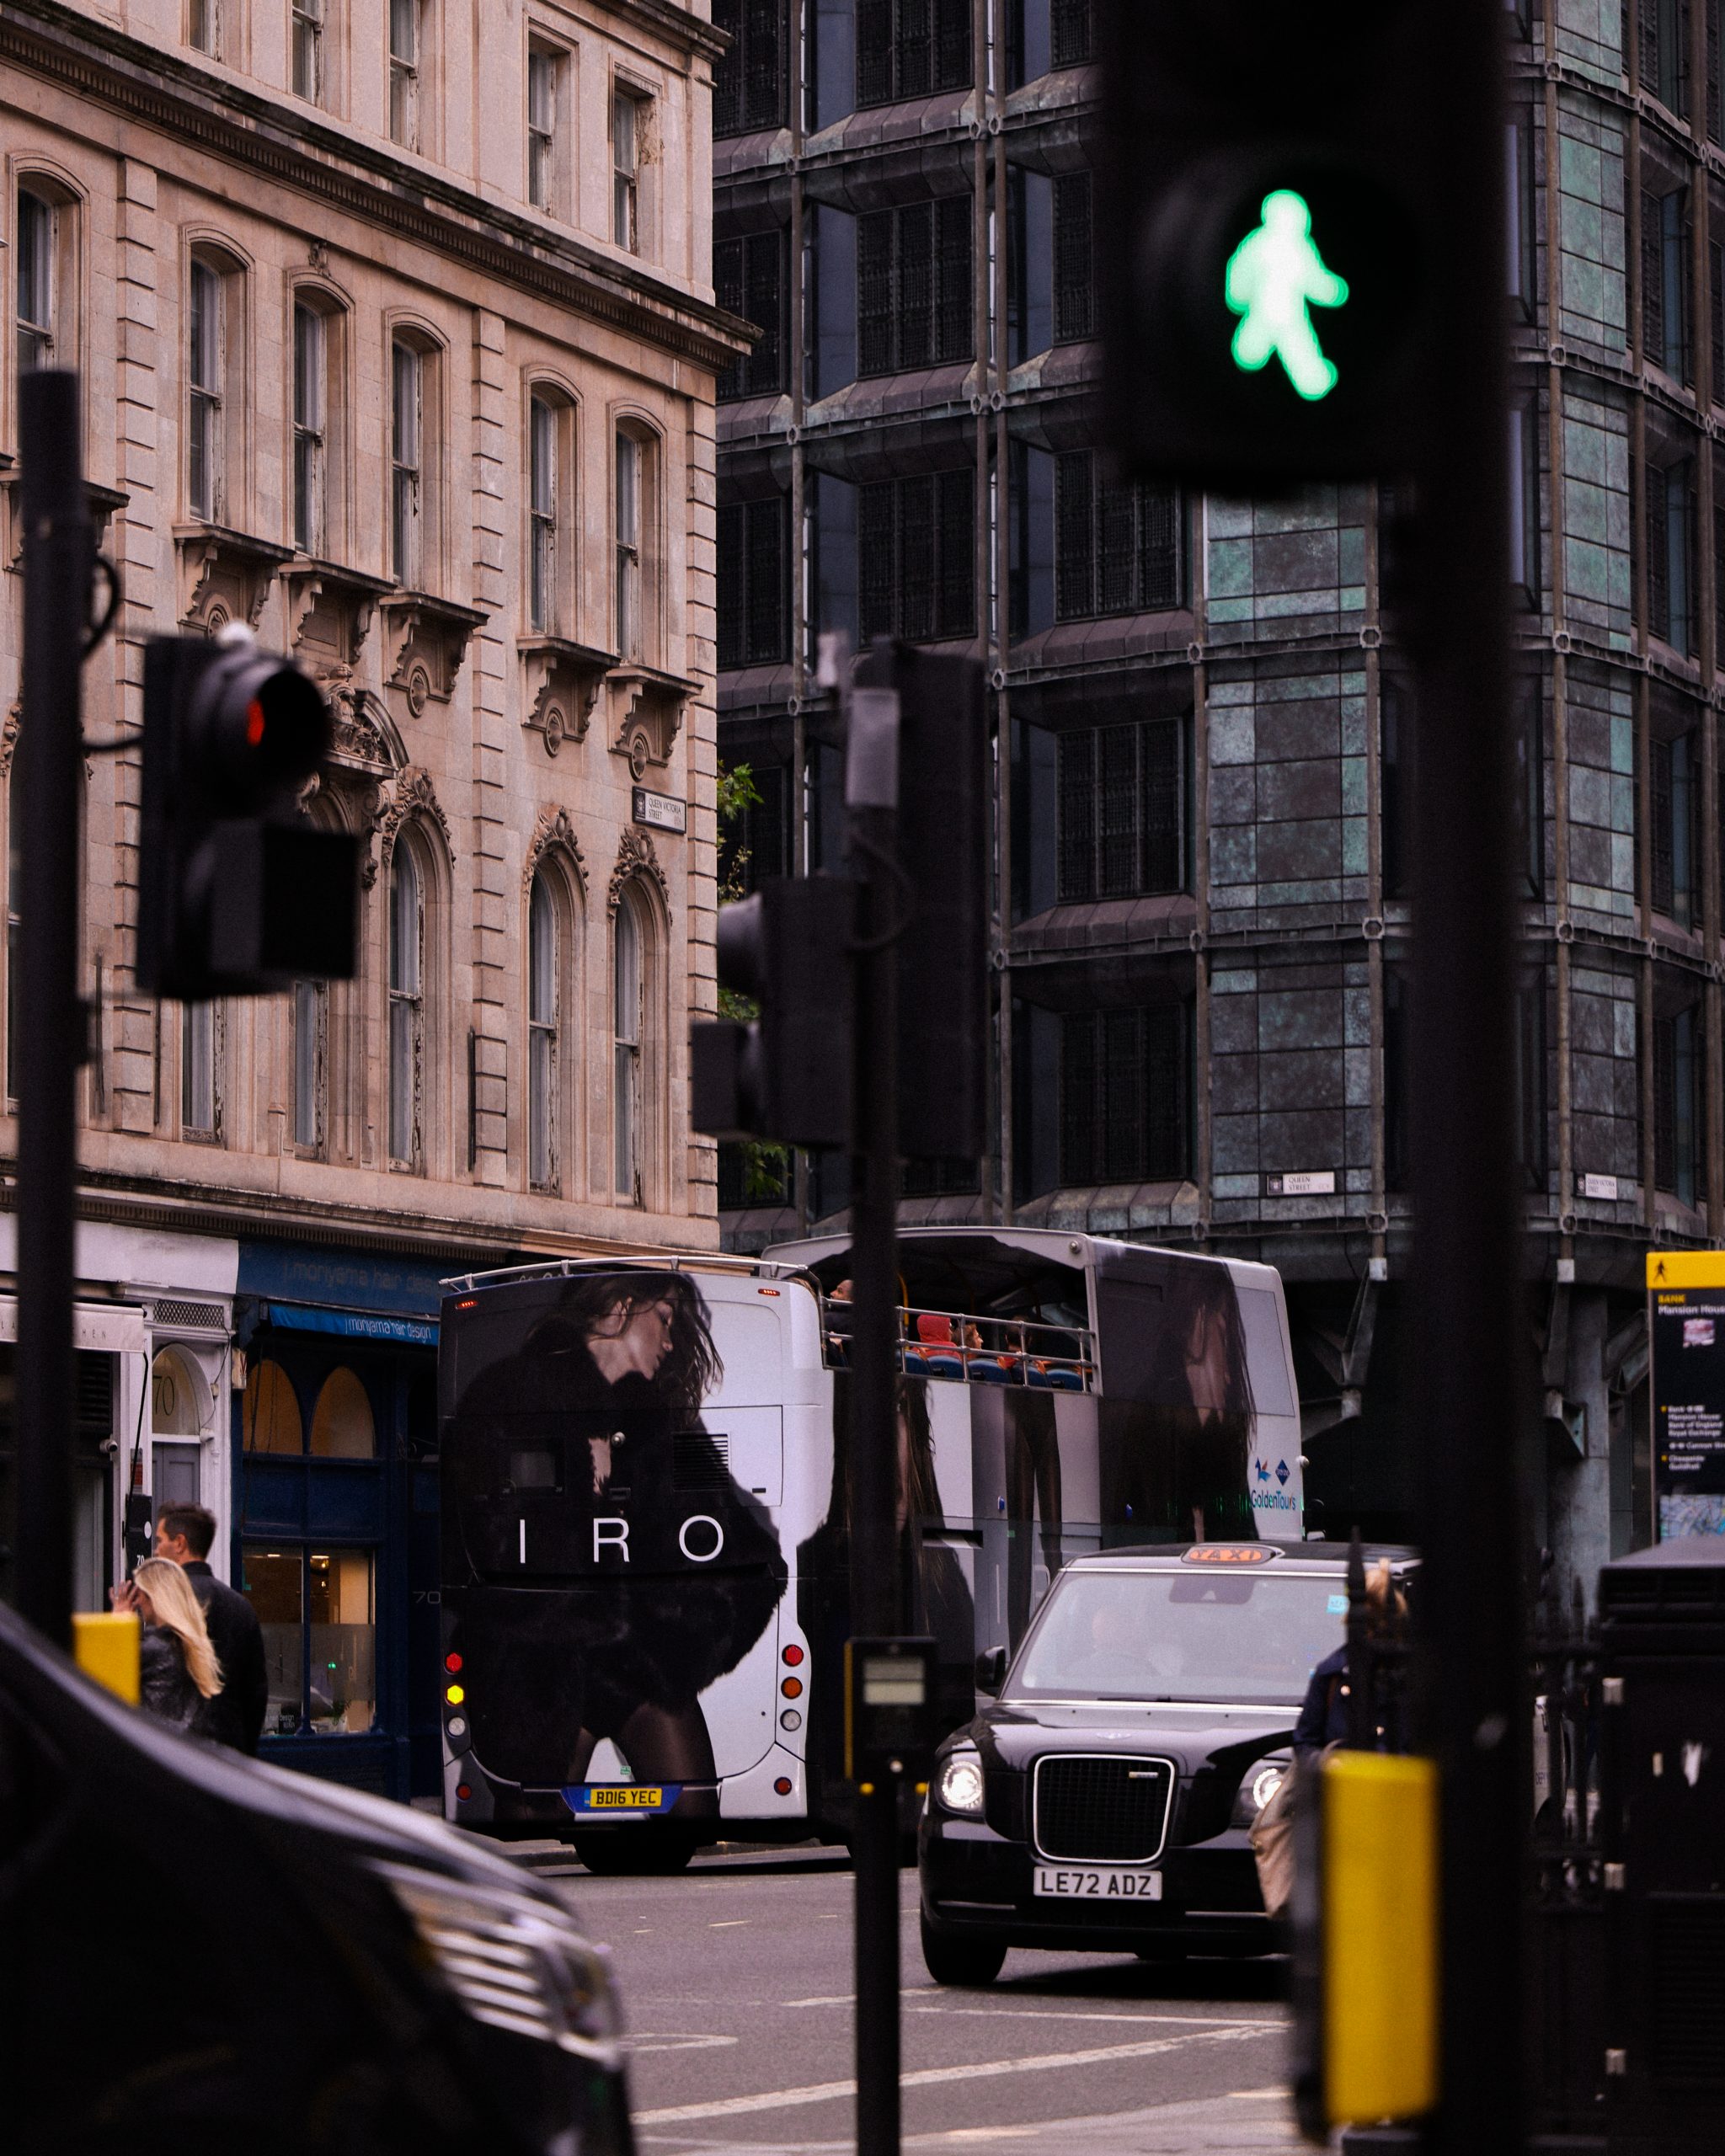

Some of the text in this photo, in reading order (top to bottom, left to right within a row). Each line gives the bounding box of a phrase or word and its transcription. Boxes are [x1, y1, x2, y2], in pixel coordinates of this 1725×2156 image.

[649, 798, 681, 814] QUEEN VICTORIA
[649, 809, 662, 820] STREET
[1658, 1294, 1686, 1304] BANK
[1658, 1304, 1725, 1315] Mansion Hous
[389, 1320, 406, 1336] hair
[408, 1321, 431, 1343] design
[152, 1375, 175, 1417] 70
[1196, 1548, 1255, 1560] TAXI
[411, 1591, 441, 1604] 70
[596, 1790, 656, 1805] BD16 YEC
[1041, 1871, 1151, 1896] LE72 ADZ
